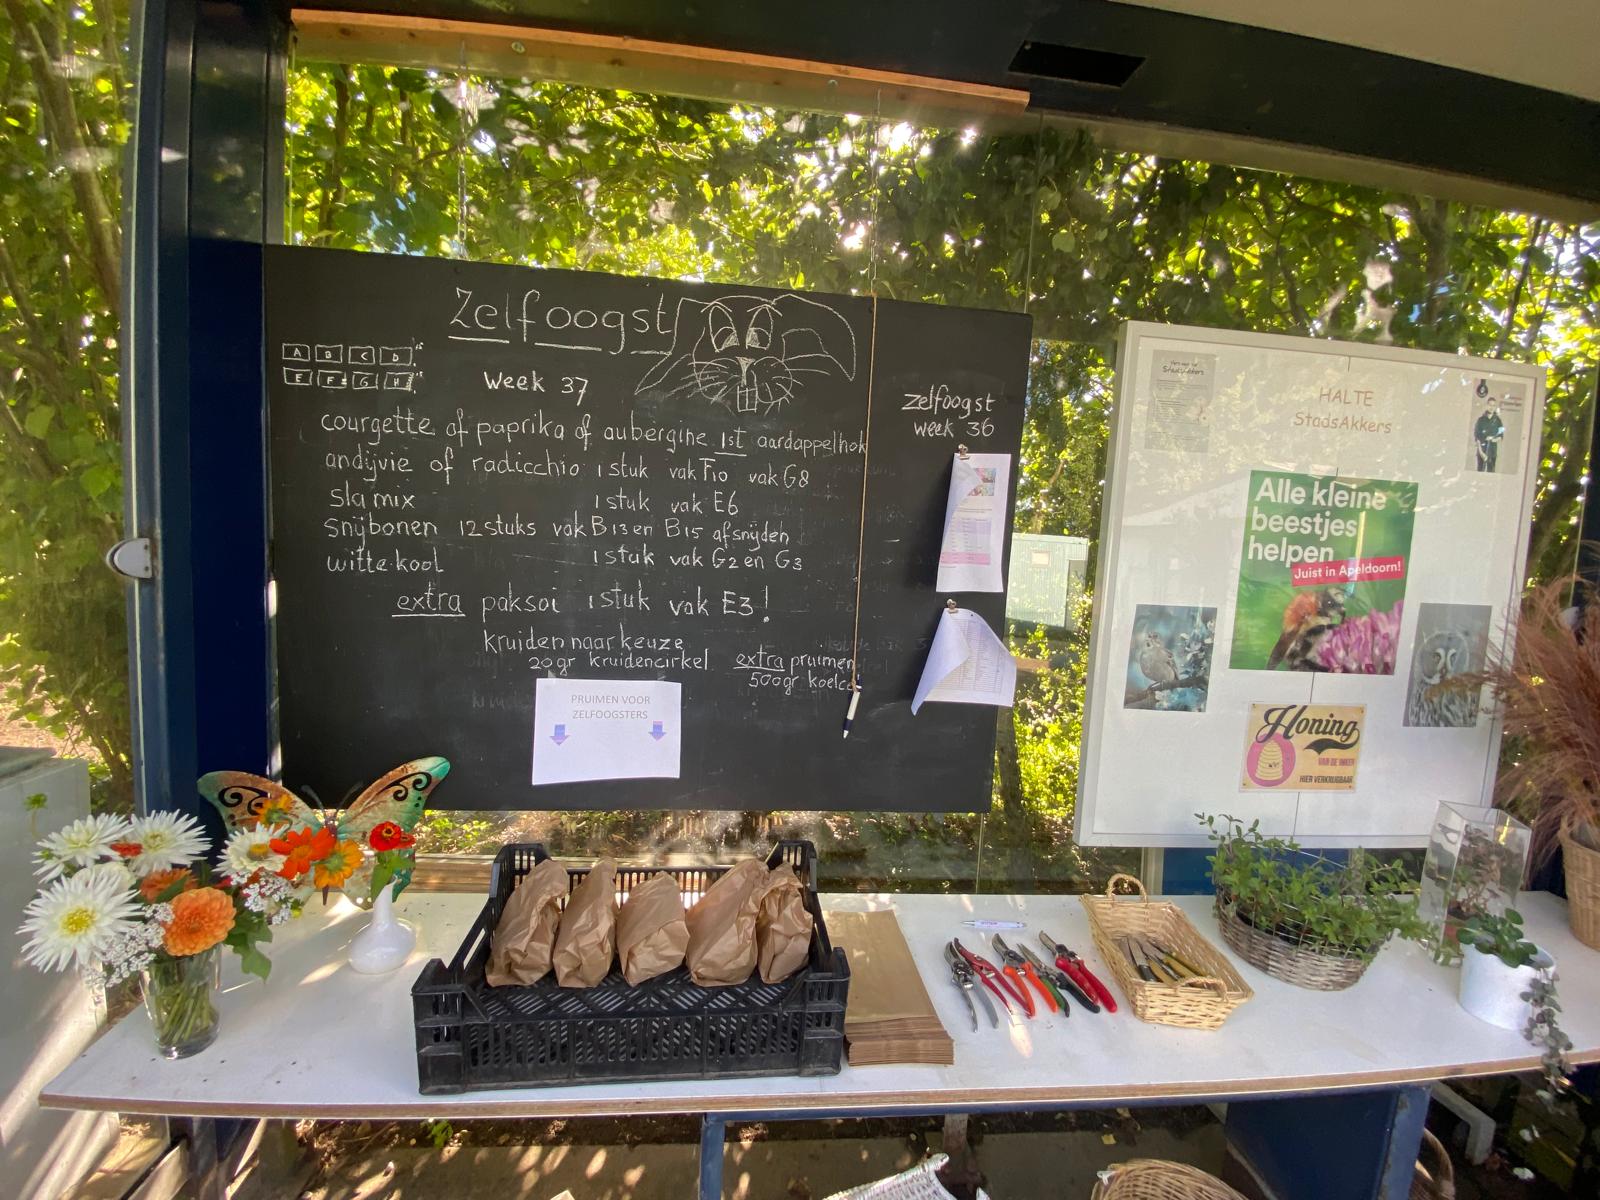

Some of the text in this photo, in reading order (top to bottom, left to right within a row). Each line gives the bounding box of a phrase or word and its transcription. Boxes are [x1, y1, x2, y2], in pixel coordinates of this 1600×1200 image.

[450, 287, 672, 354] Zelfoogst
[561, 377, 588, 406] 37
[1319, 387, 1374, 407] HALTE
[321, 406, 436, 445] courgette
[446, 408, 469, 447] of
[477, 410, 565, 446] paprika
[575, 413, 592, 451] of
[604, 411, 708, 452] aubergine
[757, 430, 868, 458] aardappelhok
[913, 417, 995, 437] week 36
[1293, 411, 1392, 434] StadsAkkers
[325, 443, 413, 481] andijvie
[430, 446, 454, 485] of
[473, 450, 580, 477] radicchio
[608, 452, 649, 479] stuk
[669, 455, 697, 481] vak
[748, 463, 778, 487] vak
[783, 464, 809, 489] G8
[606, 487, 651, 512] stuk
[670, 492, 703, 515] vak
[714, 490, 739, 515] E6
[1255, 477, 1387, 511] Alle kleine
[460, 519, 483, 537] 12
[484, 513, 537, 537] stuks
[553, 510, 587, 538] vak
[665, 518, 704, 538] B15
[1251, 506, 1357, 542] beestjes
[604, 543, 655, 567] stuk
[669, 550, 704, 571] vak
[743, 557, 765, 570] en
[775, 550, 803, 572] G3
[1248, 535, 1334, 568] helpen
[1294, 561, 1401, 580] Juist in Apeldoorn!
[396, 581, 463, 613] extra
[482, 581, 561, 623] paksoi
[600, 579, 650, 611] stuk
[669, 586, 709, 617] vak
[571, 636, 616, 651] naar
[620, 622, 684, 651] keuze
[589, 648, 708, 671] kruidencirkel
[735, 643, 784, 669] extra
[571, 694, 651, 705] PRUIMEN VOOR
[572, 709, 649, 720] ZELFOOGSTERS
[1255, 704, 1360, 744] Honing
